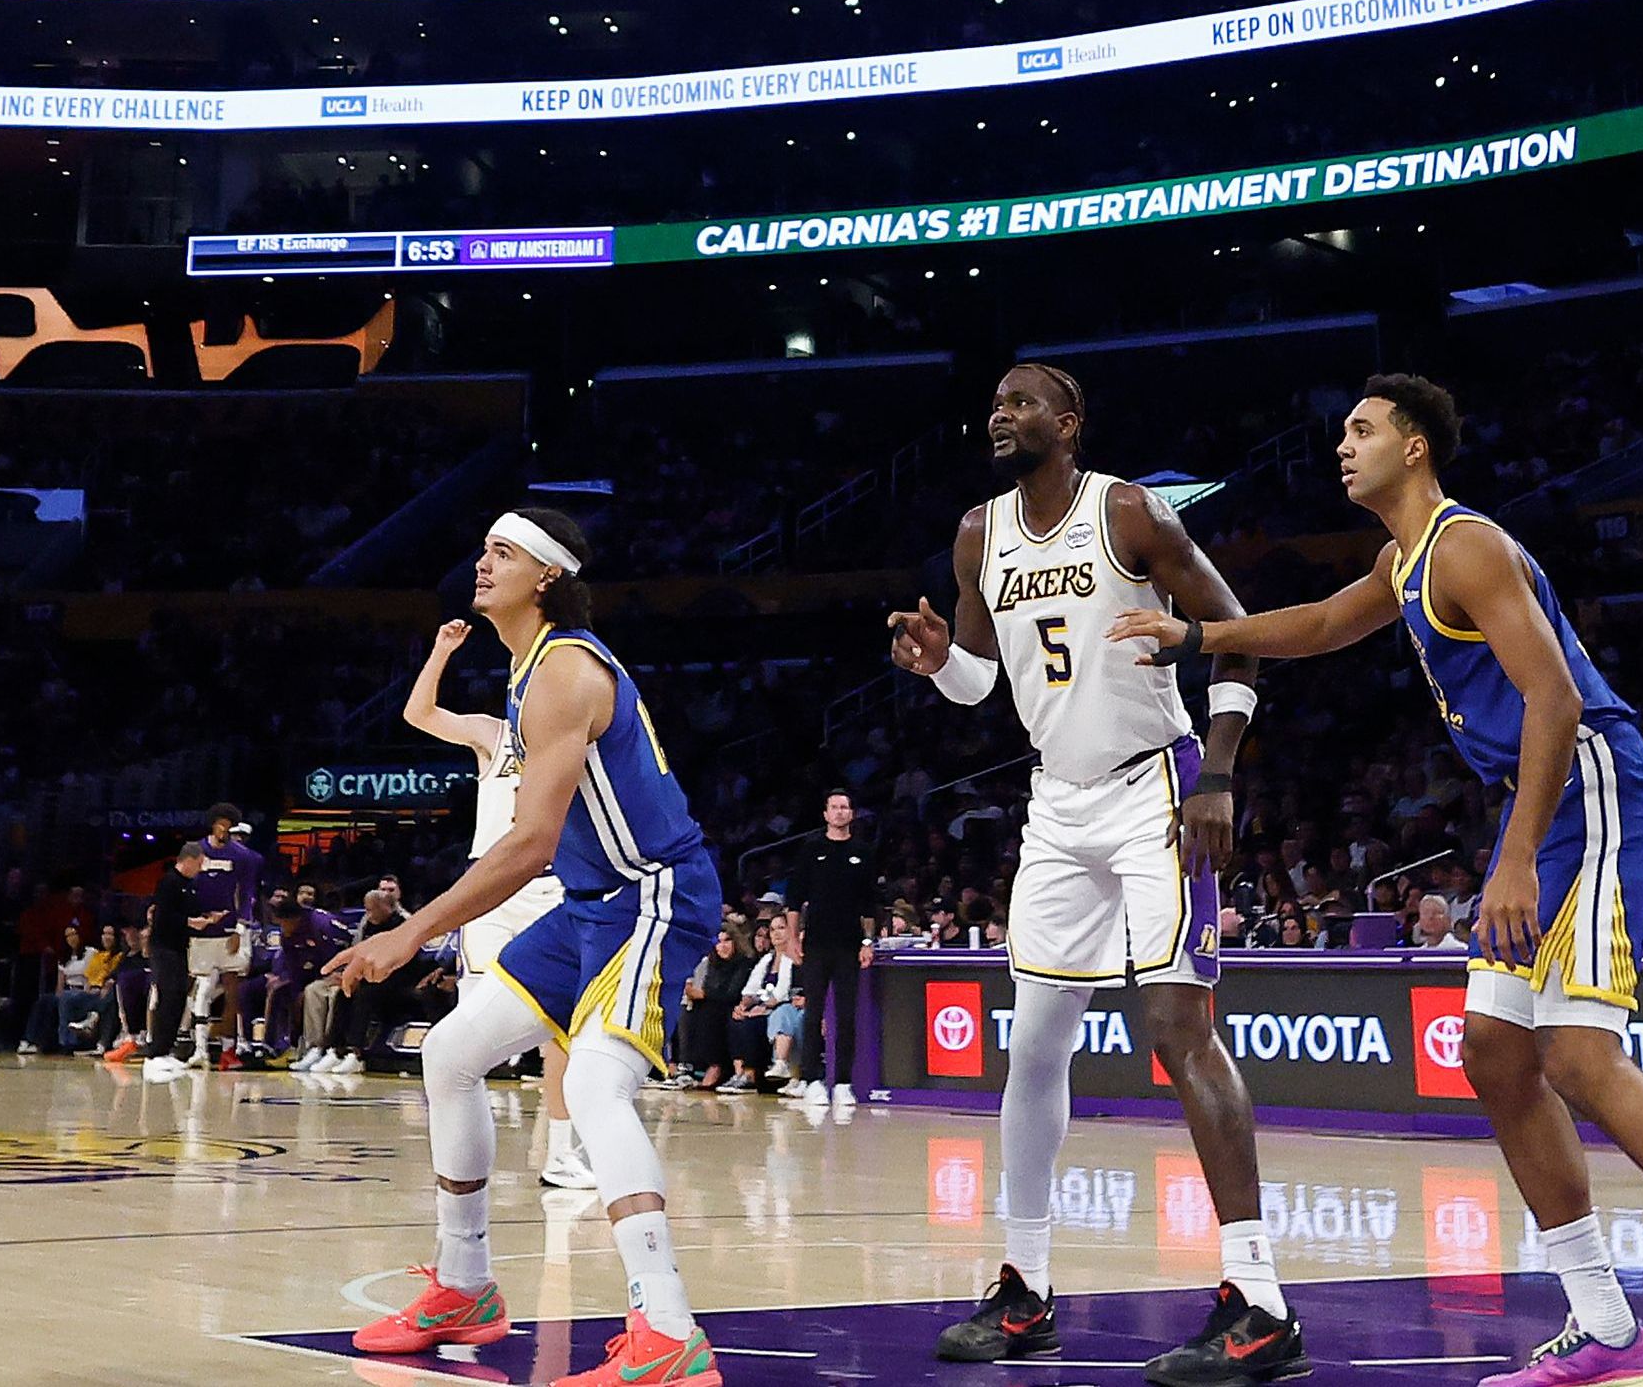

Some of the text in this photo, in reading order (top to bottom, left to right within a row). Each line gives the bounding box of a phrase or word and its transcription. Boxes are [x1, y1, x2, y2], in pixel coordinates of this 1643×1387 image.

[1212, 18, 1260, 45] KEEP
[1268, 11, 1294, 36] ON
[1021, 42, 1117, 69] UCLA Health
[522, 62, 918, 112] KEEP ON OVERCOMING EVERY CHALLENGE
[43, 97, 105, 120] EVERY
[112, 98, 225, 122] CHALLENGE
[325, 96, 424, 114] UCLA Health
[695, 126, 1577, 258] CALIFORNIA'S #1 ENTERTAINMENT DESTINATION
[282, 238, 348, 252] Exchange
[408, 240, 455, 262] 6:53
[490, 242, 518, 259] NEW
[519, 239, 595, 259] AMSTERDAM
[993, 562, 1097, 613] LAKERS
[1036, 617, 1075, 687] 5
[1225, 1013, 1393, 1065] TOYOTA
